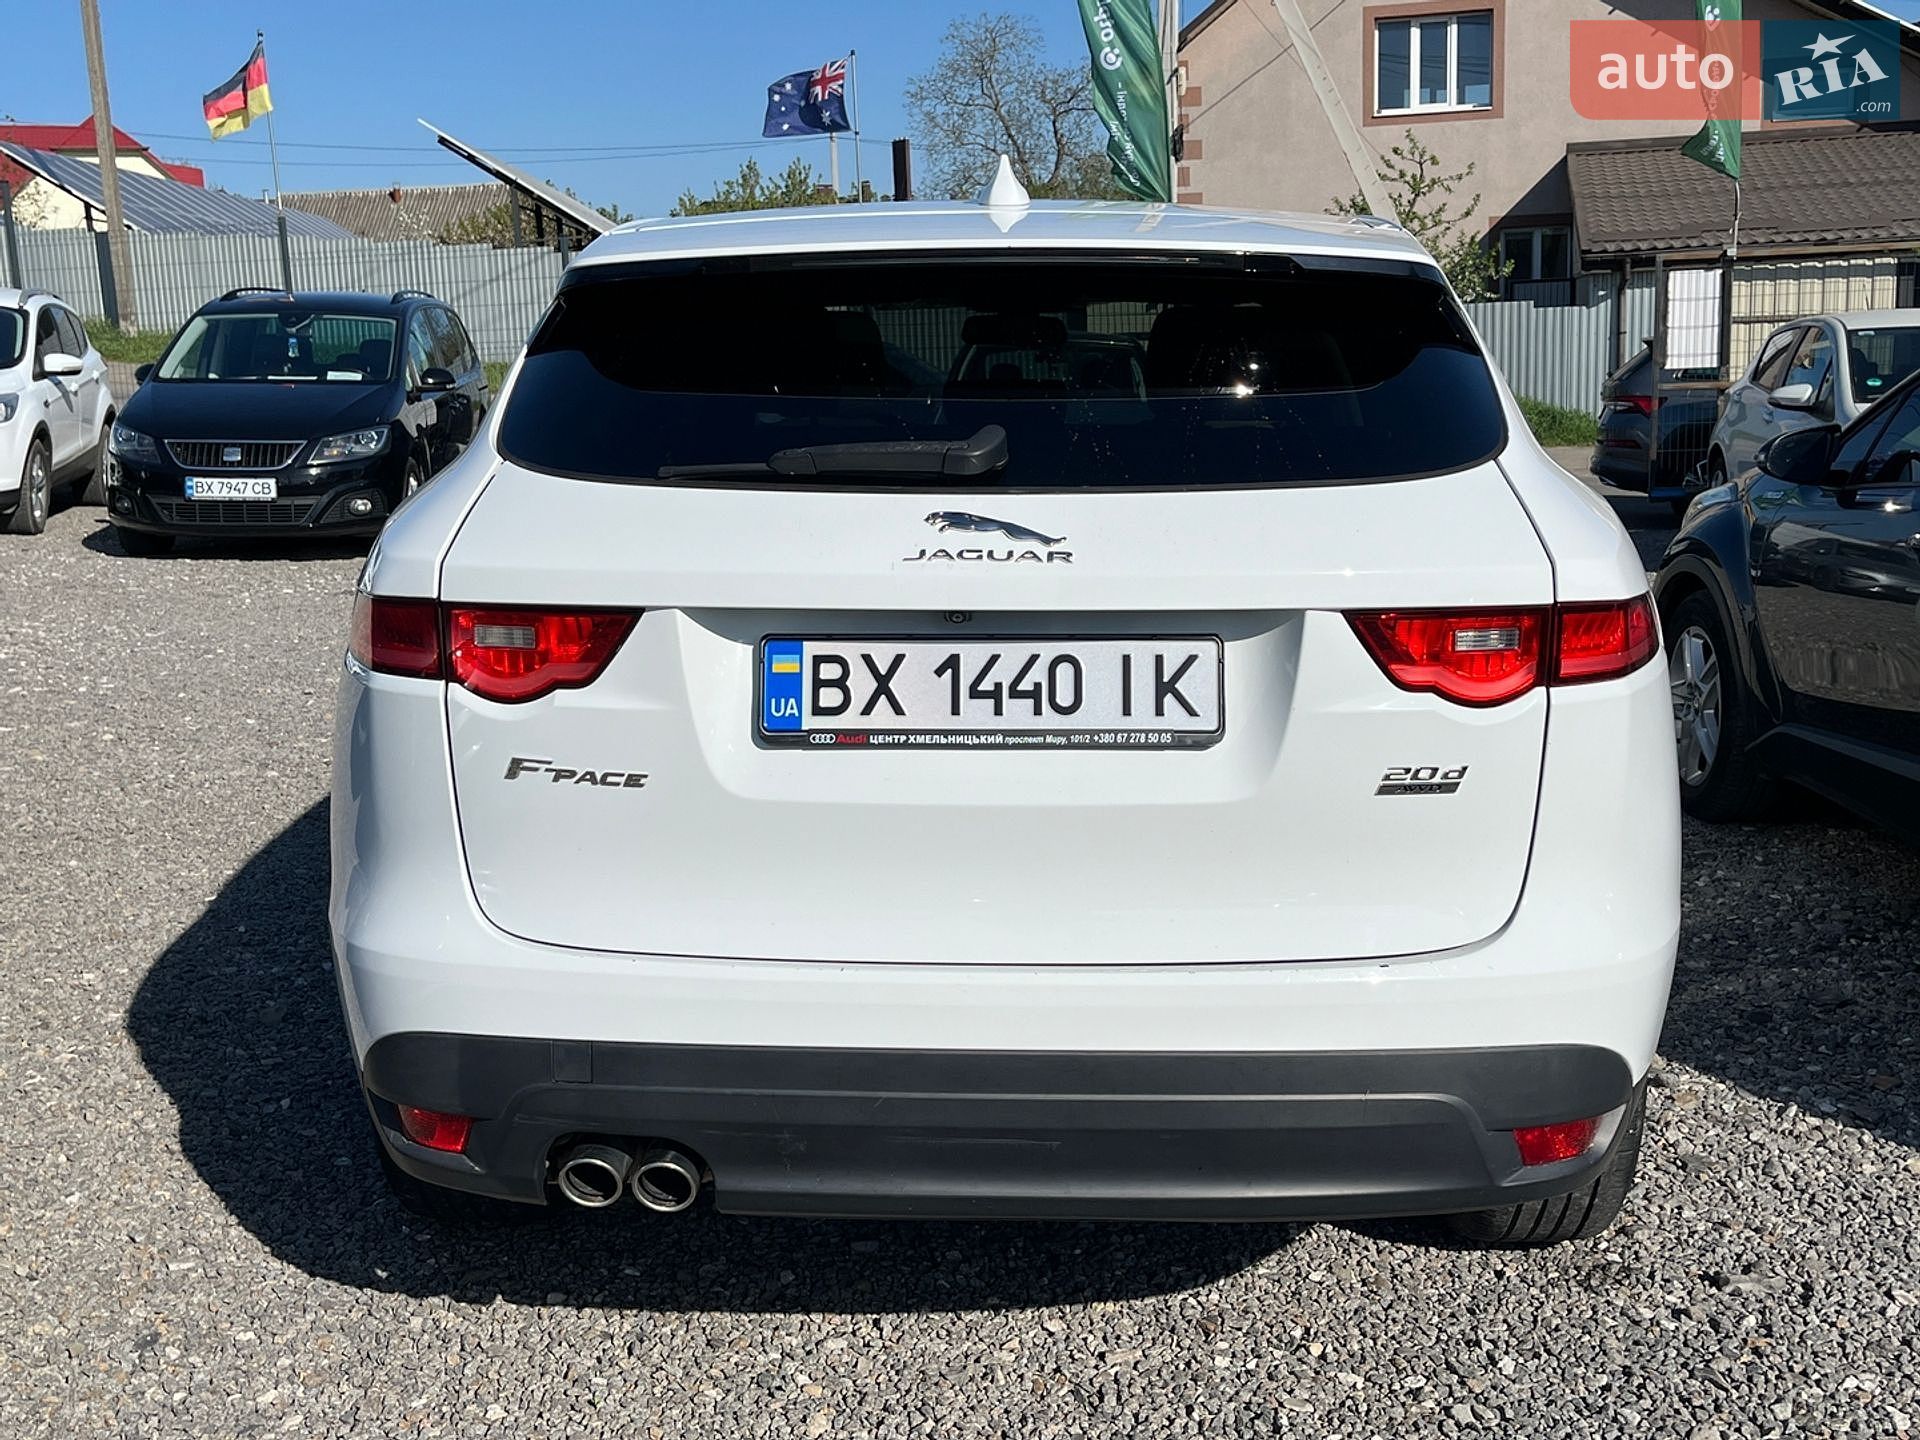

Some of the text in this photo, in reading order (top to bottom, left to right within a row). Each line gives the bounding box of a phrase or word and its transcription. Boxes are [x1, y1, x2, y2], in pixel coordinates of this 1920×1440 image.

[194, 481, 272, 495] BX 7947 CB
[902, 549, 1073, 564] JAGUAR
[811, 653, 1201, 717] BX 1440 IK
[770, 697, 799, 717] UA
[836, 733, 867, 744] Audi
[869, 734, 906, 745] ЦЕНТР
[908, 733, 1004, 745] ХМЕЛЬНИЦЬКИЙ
[1070, 734, 1090, 744] 101/2
[1093, 733, 1115, 744] +380
[1116, 733, 1128, 744] 67
[1129, 733, 1146, 744] 278
[1147, 733, 1159, 744] 50
[1160, 733, 1172, 744] 05
[1380, 765, 1470, 781] 20d
